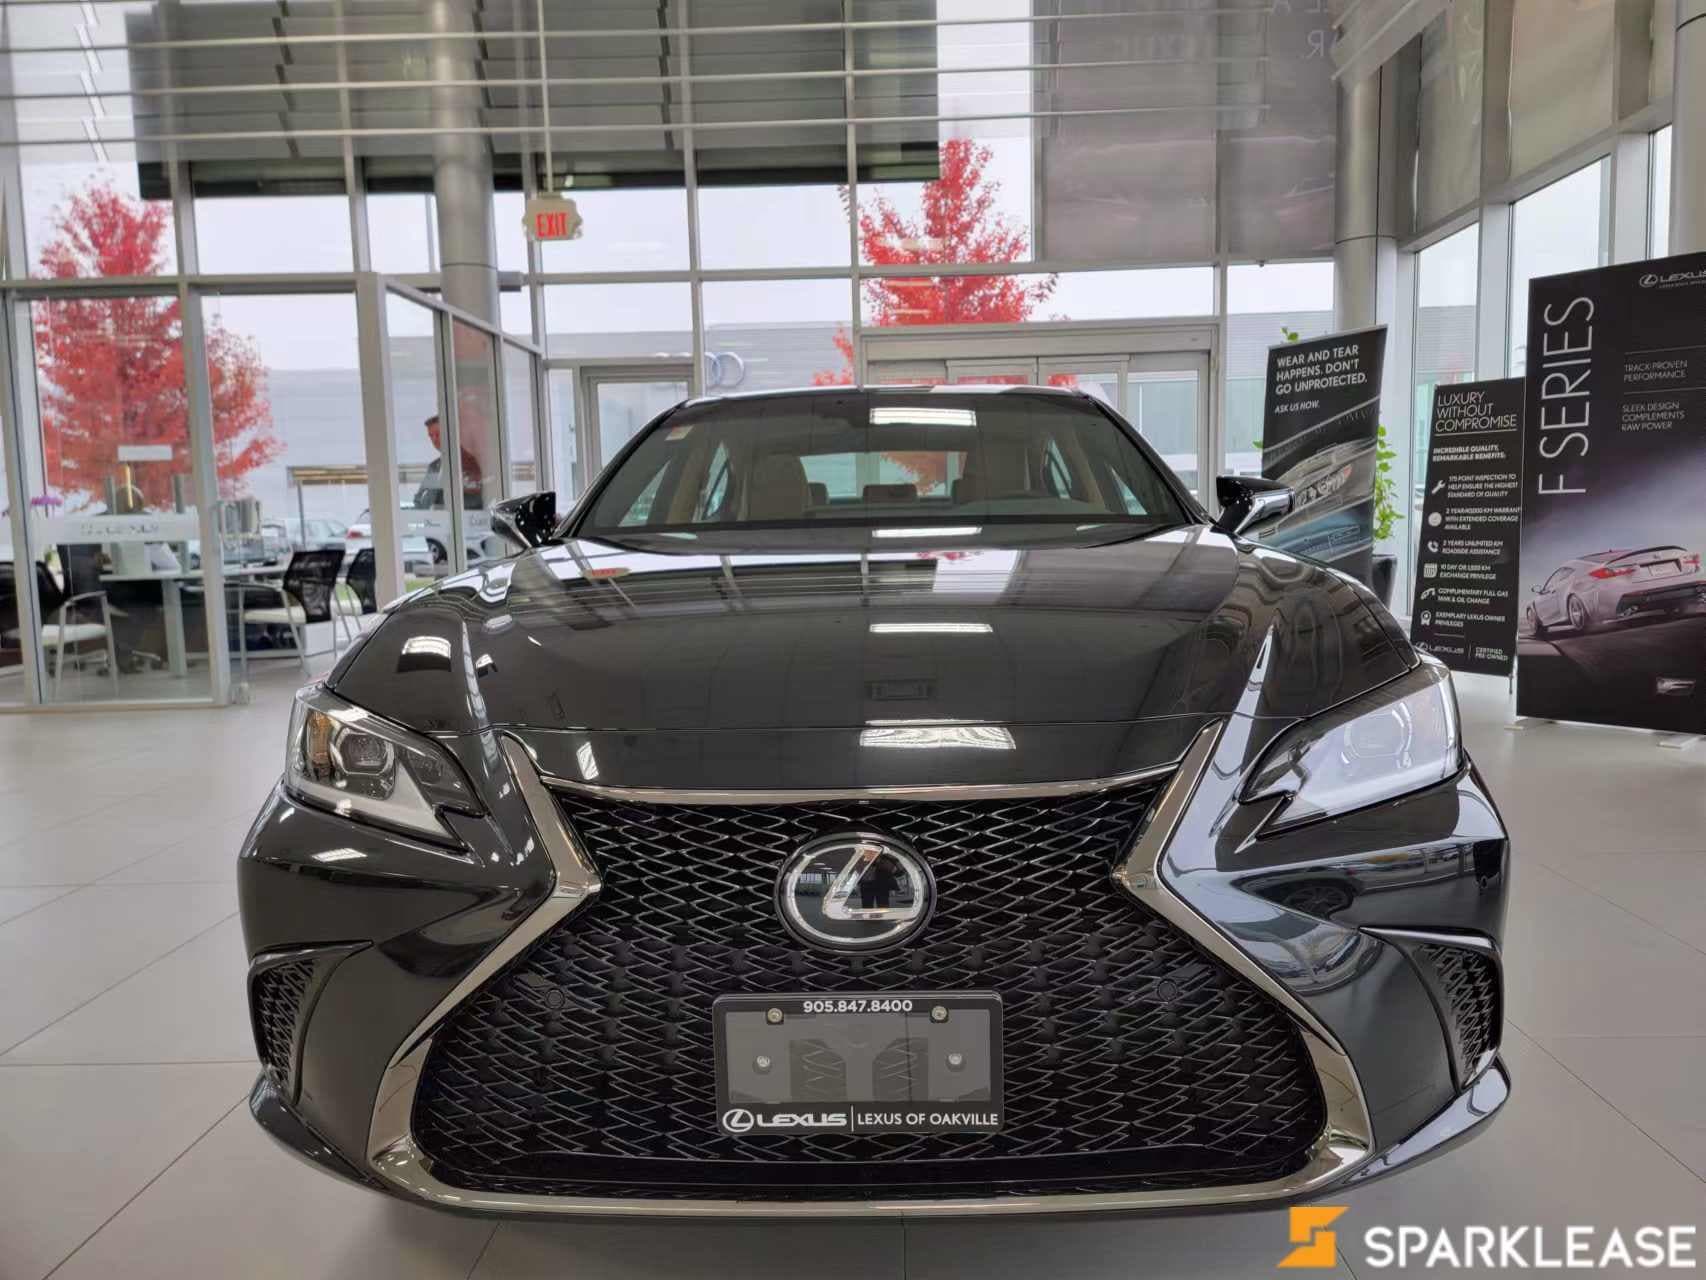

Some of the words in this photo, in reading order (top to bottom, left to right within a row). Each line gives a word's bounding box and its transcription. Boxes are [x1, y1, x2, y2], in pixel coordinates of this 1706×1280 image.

[535, 212, 567, 237] EXIT
[1277, 355, 1305, 368] WEAR
[1307, 350, 1330, 362] AND
[1333, 344, 1359, 358] TEAR
[1326, 358, 1360, 374] DON'T
[1624, 363, 1650, 372] TRACK
[1652, 360, 1688, 369] PROVEN
[1275, 384, 1292, 395] GO
[1295, 372, 1368, 393] UNPROTECTED.
[1539, 297, 1594, 458] SERIES
[1623, 370, 1686, 383] PERFORMANCE
[1438, 391, 1486, 407] LUXURY
[1275, 402, 1289, 414] ASK
[1290, 402, 1299, 412] US
[1437, 403, 1494, 418] WITHOUT
[1622, 403, 1645, 413] SLEEK
[1647, 401, 1680, 411] DESIGN
[1622, 409, 1685, 422] COMPLEMENTS
[1435, 414, 1518, 432] COMPROMISE
[1621, 423, 1640, 432] RAW
[1641, 421, 1672, 430] POWER
[1432, 453, 1473, 462] REMARKABLE
[1538, 473, 1586, 494] F
[803, 1000, 913, 1014] 905.847.8400
[756, 1113, 848, 1127] LEXUS
[857, 1112, 901, 1126] LEXUS
[905, 1112, 926, 1126] OF
[929, 1112, 999, 1126] OAKVILLE
